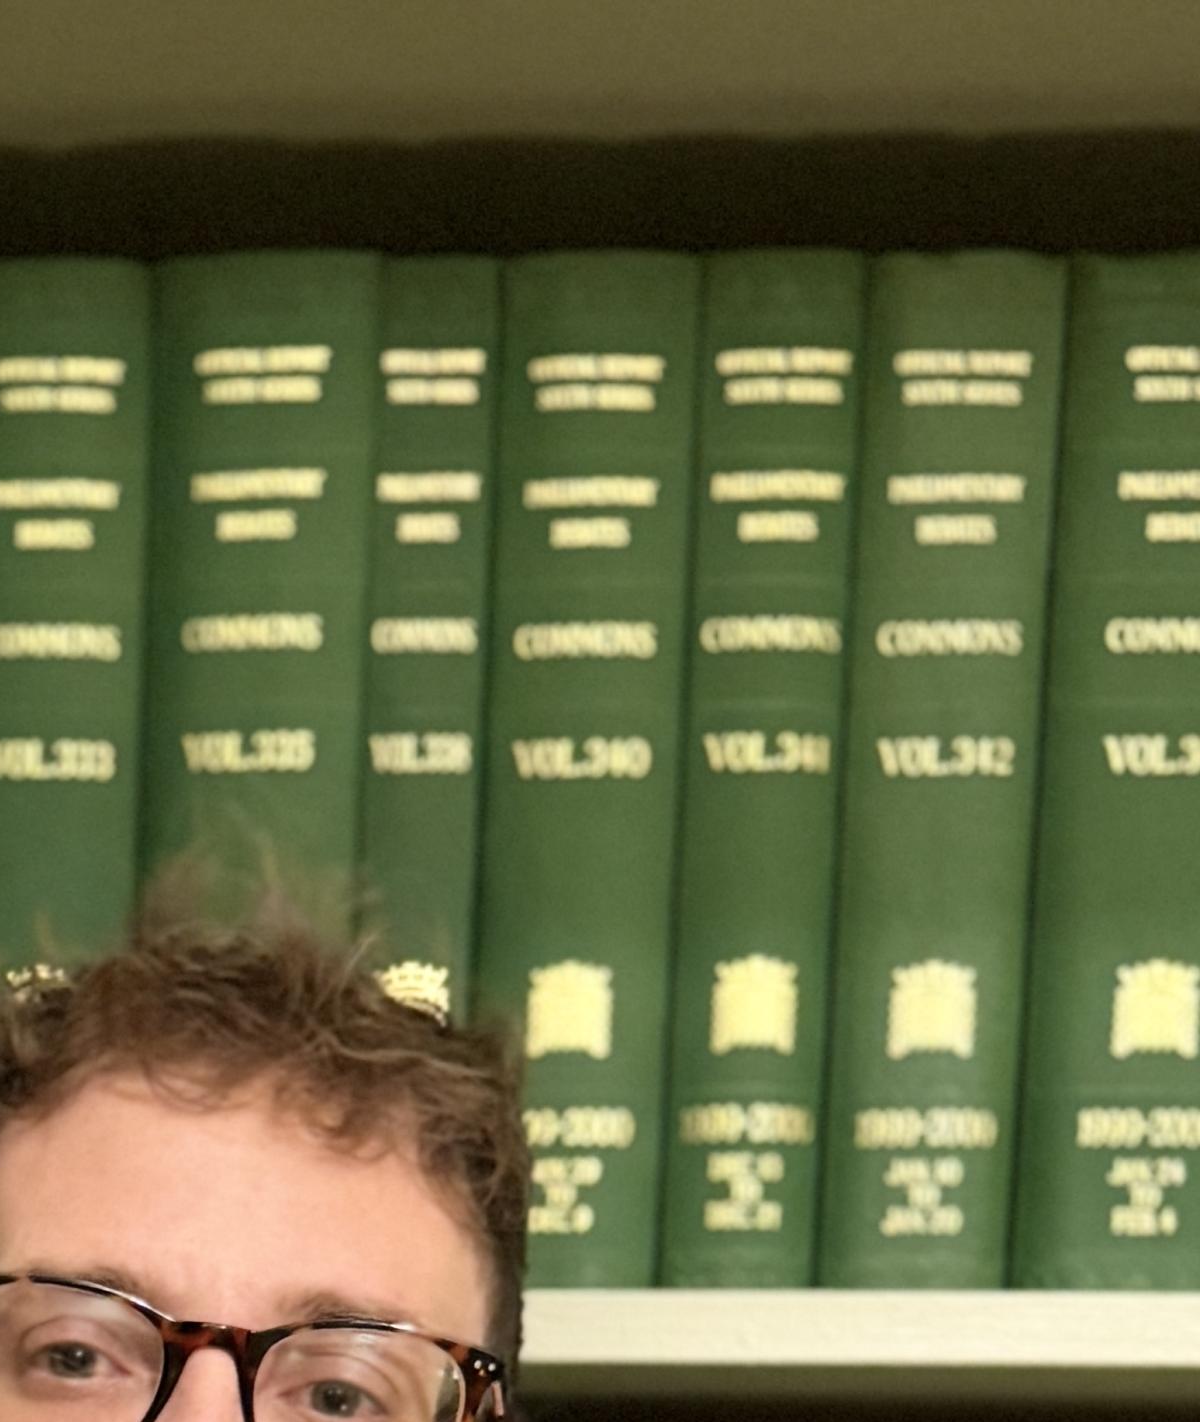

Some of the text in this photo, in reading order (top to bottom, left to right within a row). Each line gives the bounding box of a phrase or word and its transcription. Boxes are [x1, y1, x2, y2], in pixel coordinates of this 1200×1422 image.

[876, 620, 1022, 655] COMMONS
[1105, 618, 1200, 652] COMM
[1104, 735, 1200, 775] VOL.3
